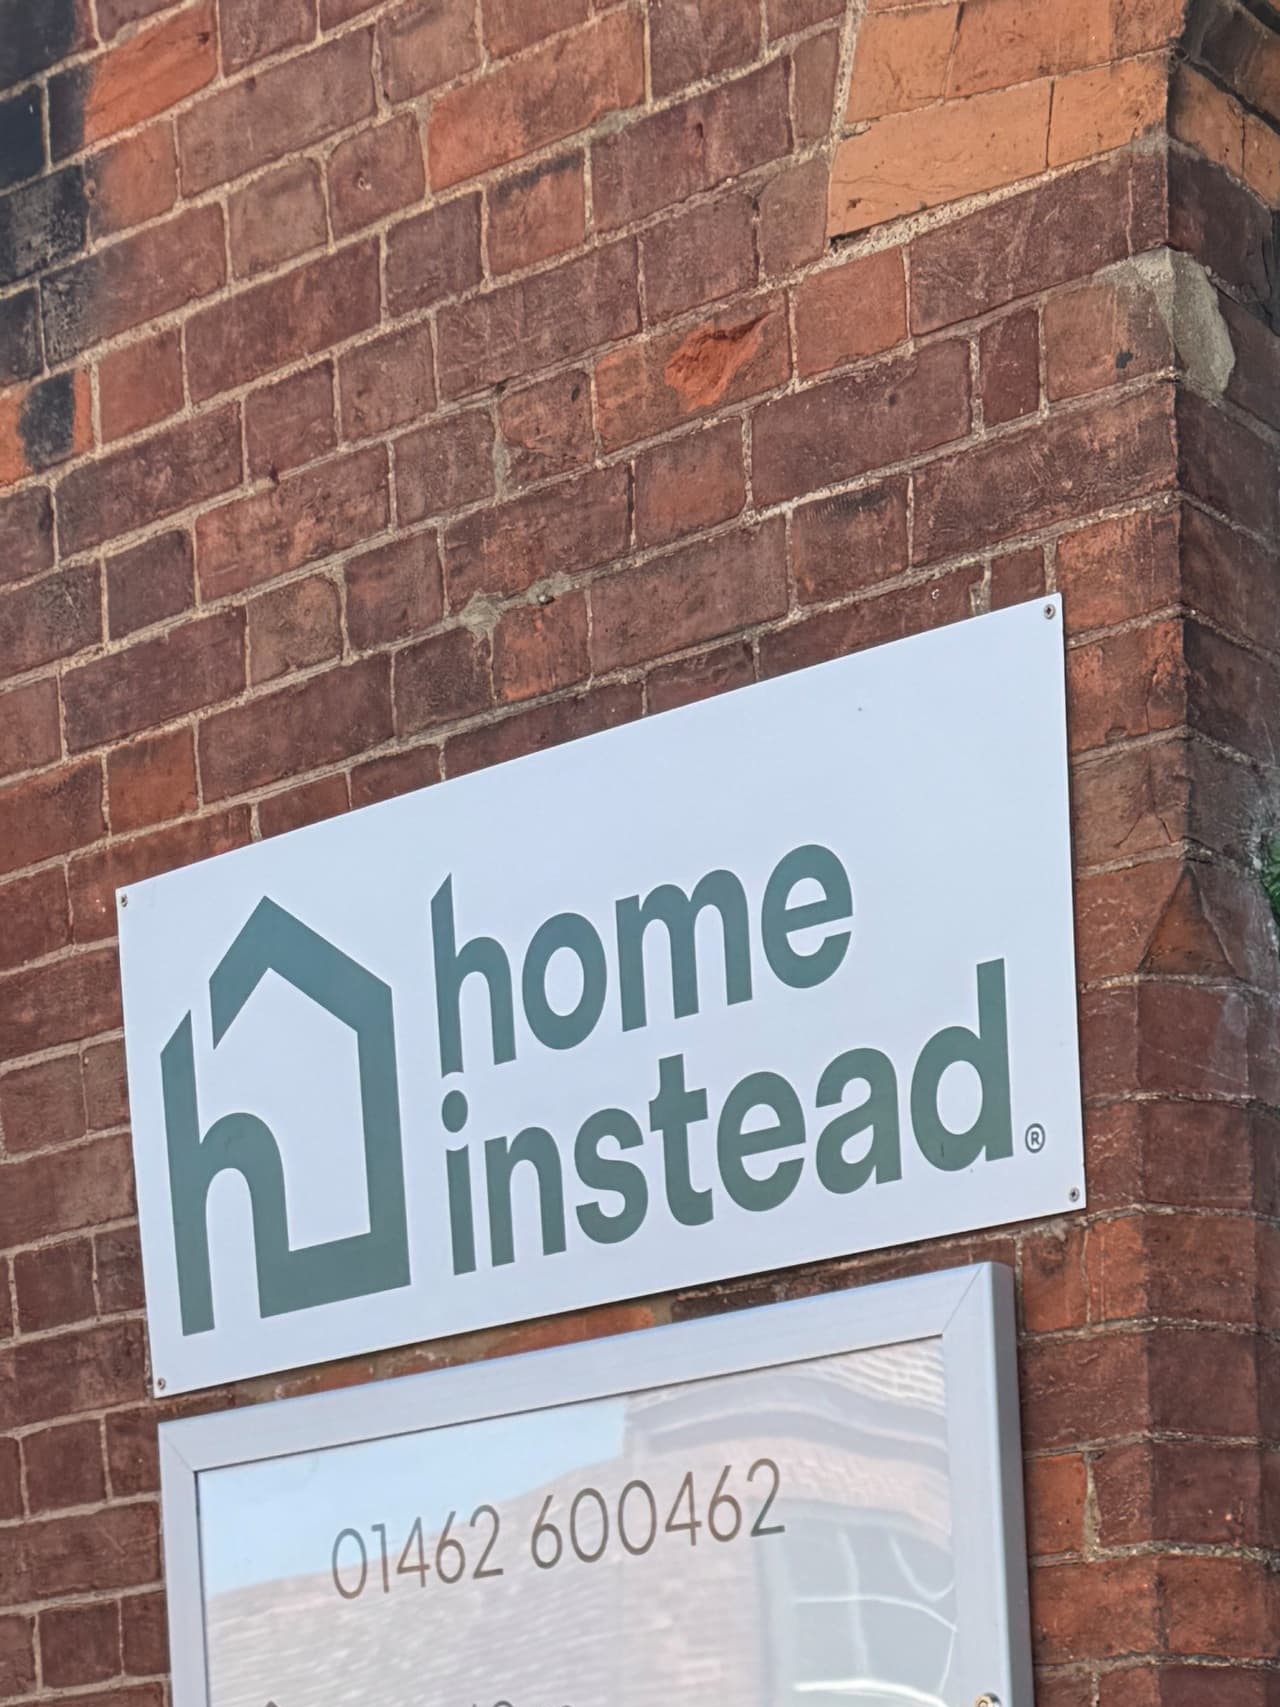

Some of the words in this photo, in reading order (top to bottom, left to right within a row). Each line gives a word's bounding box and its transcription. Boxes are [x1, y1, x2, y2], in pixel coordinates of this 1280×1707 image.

[430, 843, 854, 1074] home
[333, 1505, 504, 1599] 01462
[530, 1458, 786, 1571] 600462
